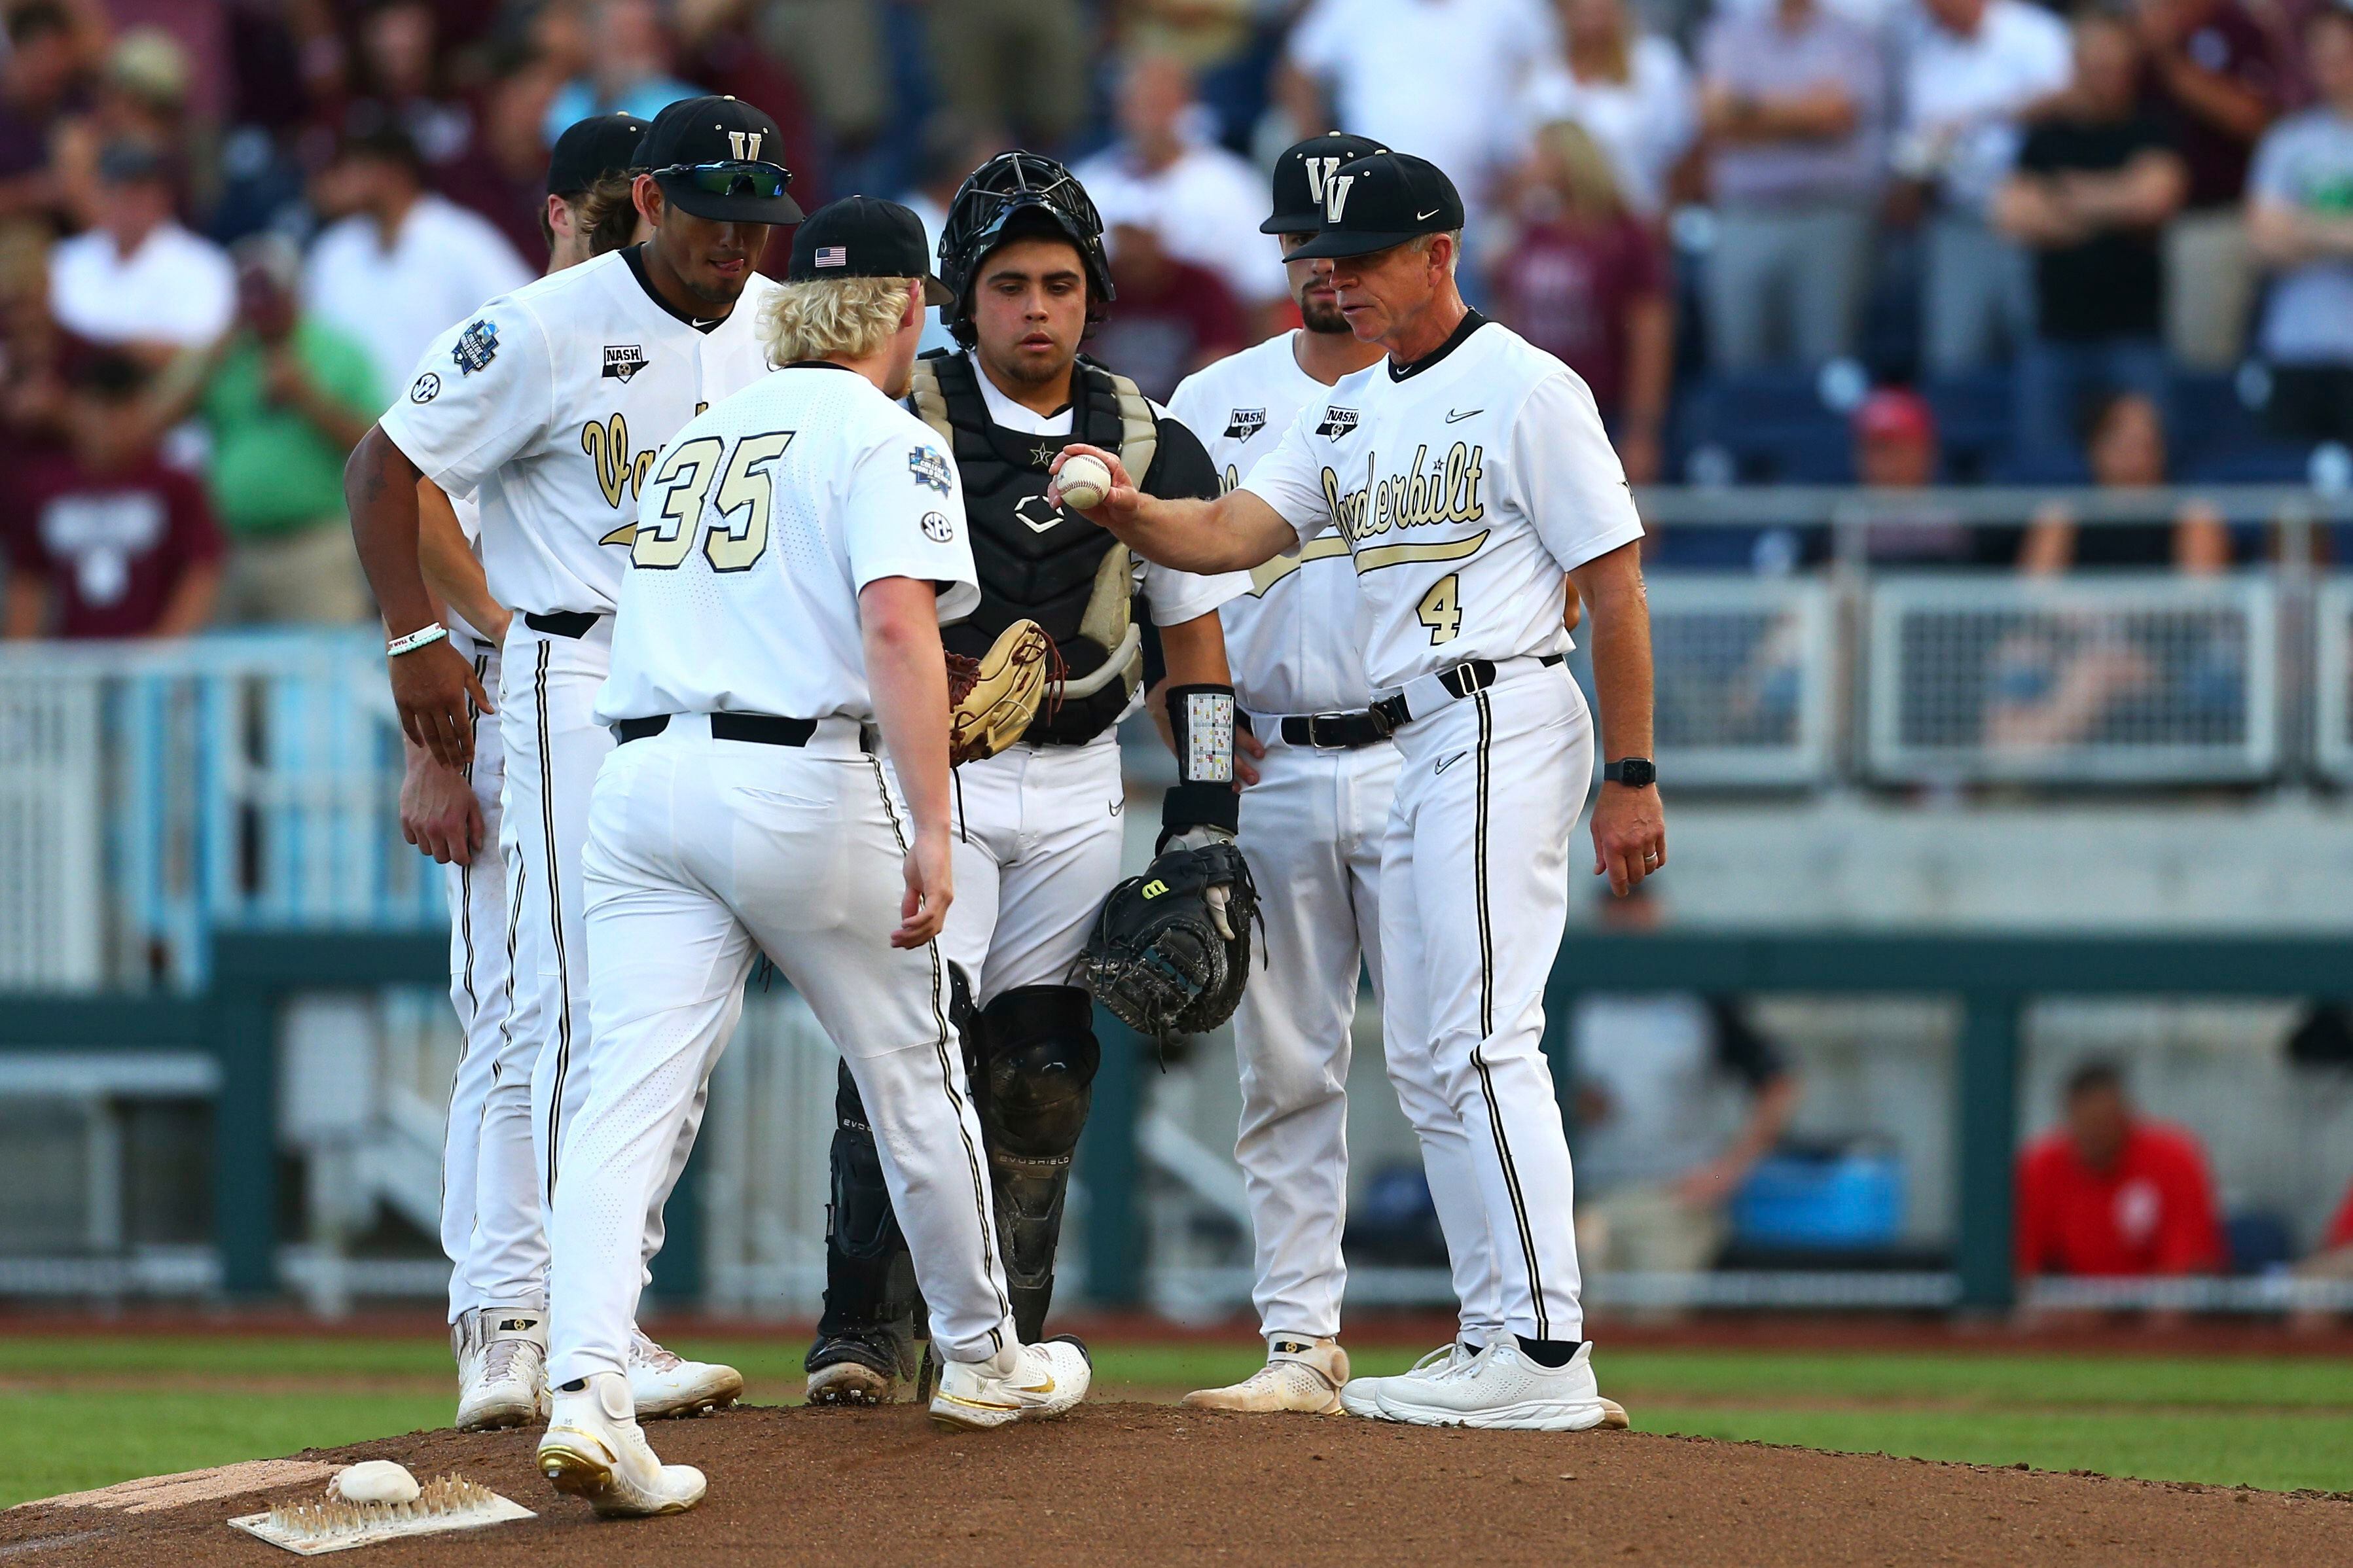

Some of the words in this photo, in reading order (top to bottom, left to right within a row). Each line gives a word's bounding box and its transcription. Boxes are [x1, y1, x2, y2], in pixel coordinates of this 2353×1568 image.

[728, 131, 762, 160] V
[1305, 157, 1340, 204] V
[1327, 175, 1354, 223] V
[607, 349, 639, 362] NASH
[413, 375, 438, 402] SEC
[1233, 412, 1263, 423] NASH
[1327, 410, 1357, 423] NASH
[630, 431, 795, 573] 35
[924, 512, 952, 541] SEC
[1415, 573, 1463, 646] 4
